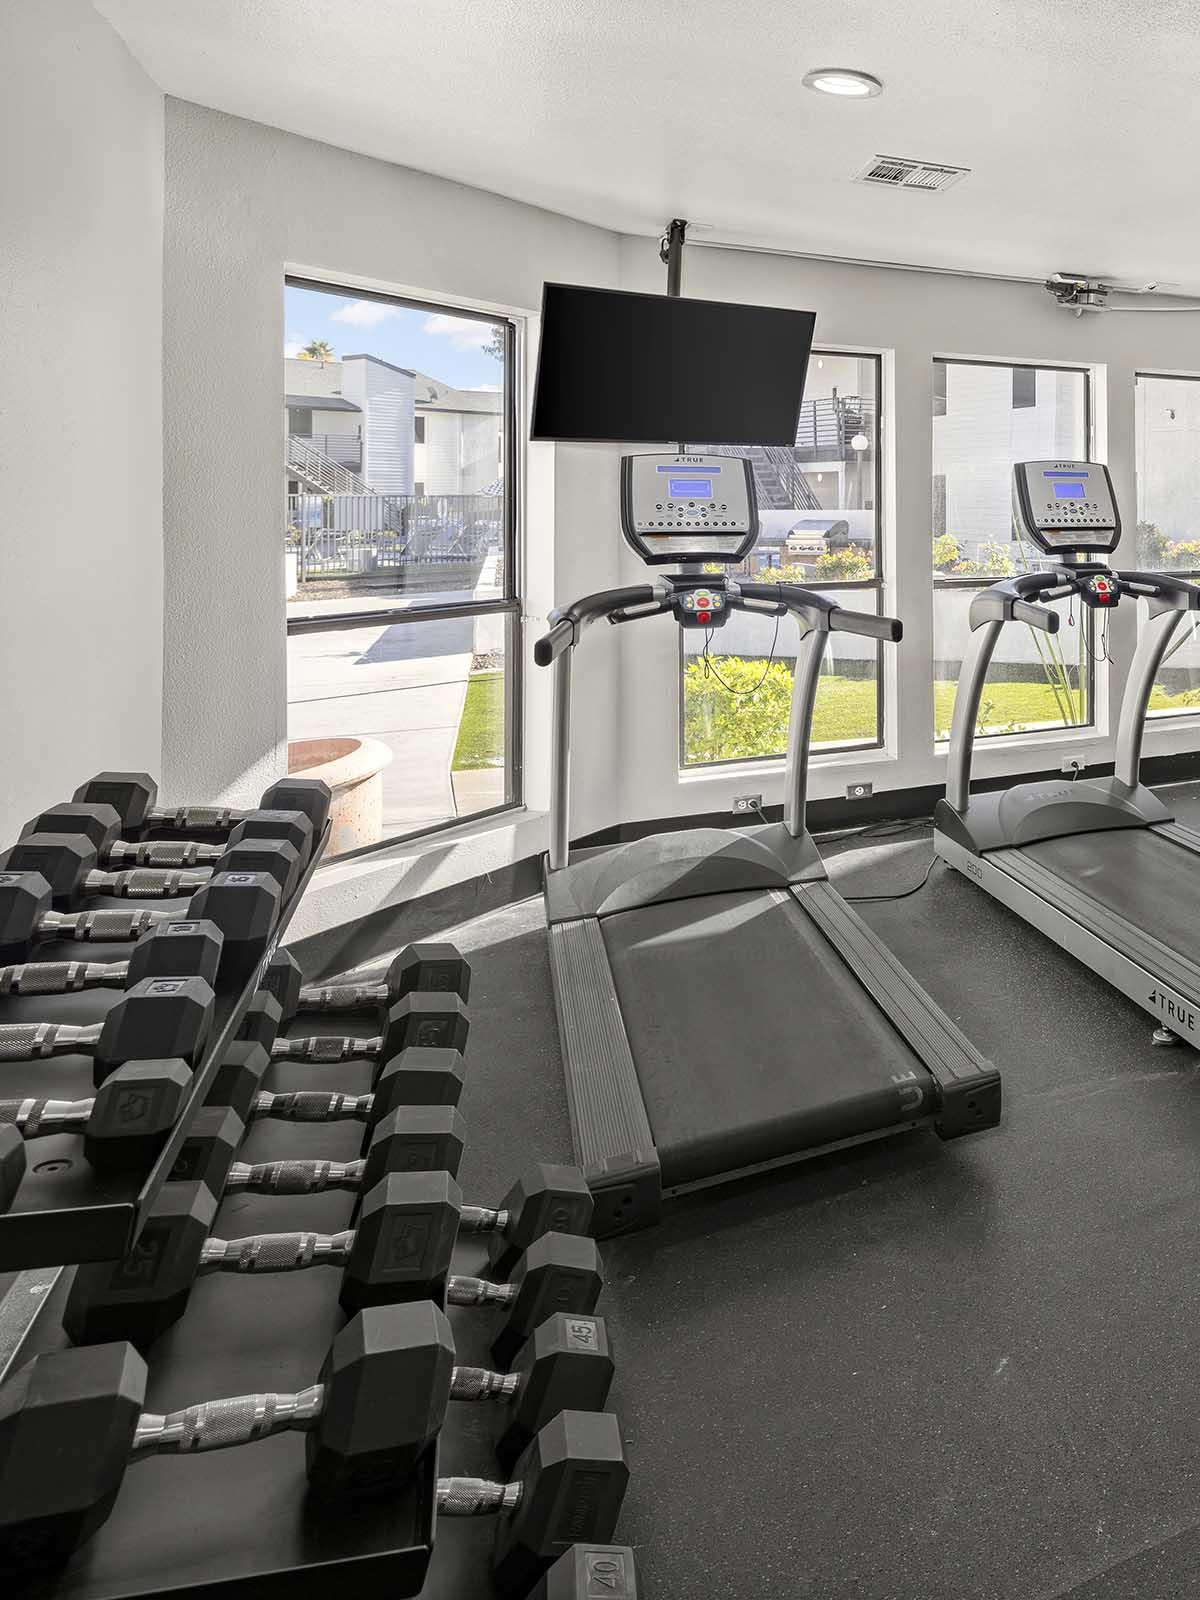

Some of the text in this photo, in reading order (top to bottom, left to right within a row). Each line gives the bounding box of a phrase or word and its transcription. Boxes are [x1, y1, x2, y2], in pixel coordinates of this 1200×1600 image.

[1158, 992, 1195, 1031] TRUE
[571, 1325, 593, 1344] 45
[592, 1561, 619, 1589] 40
